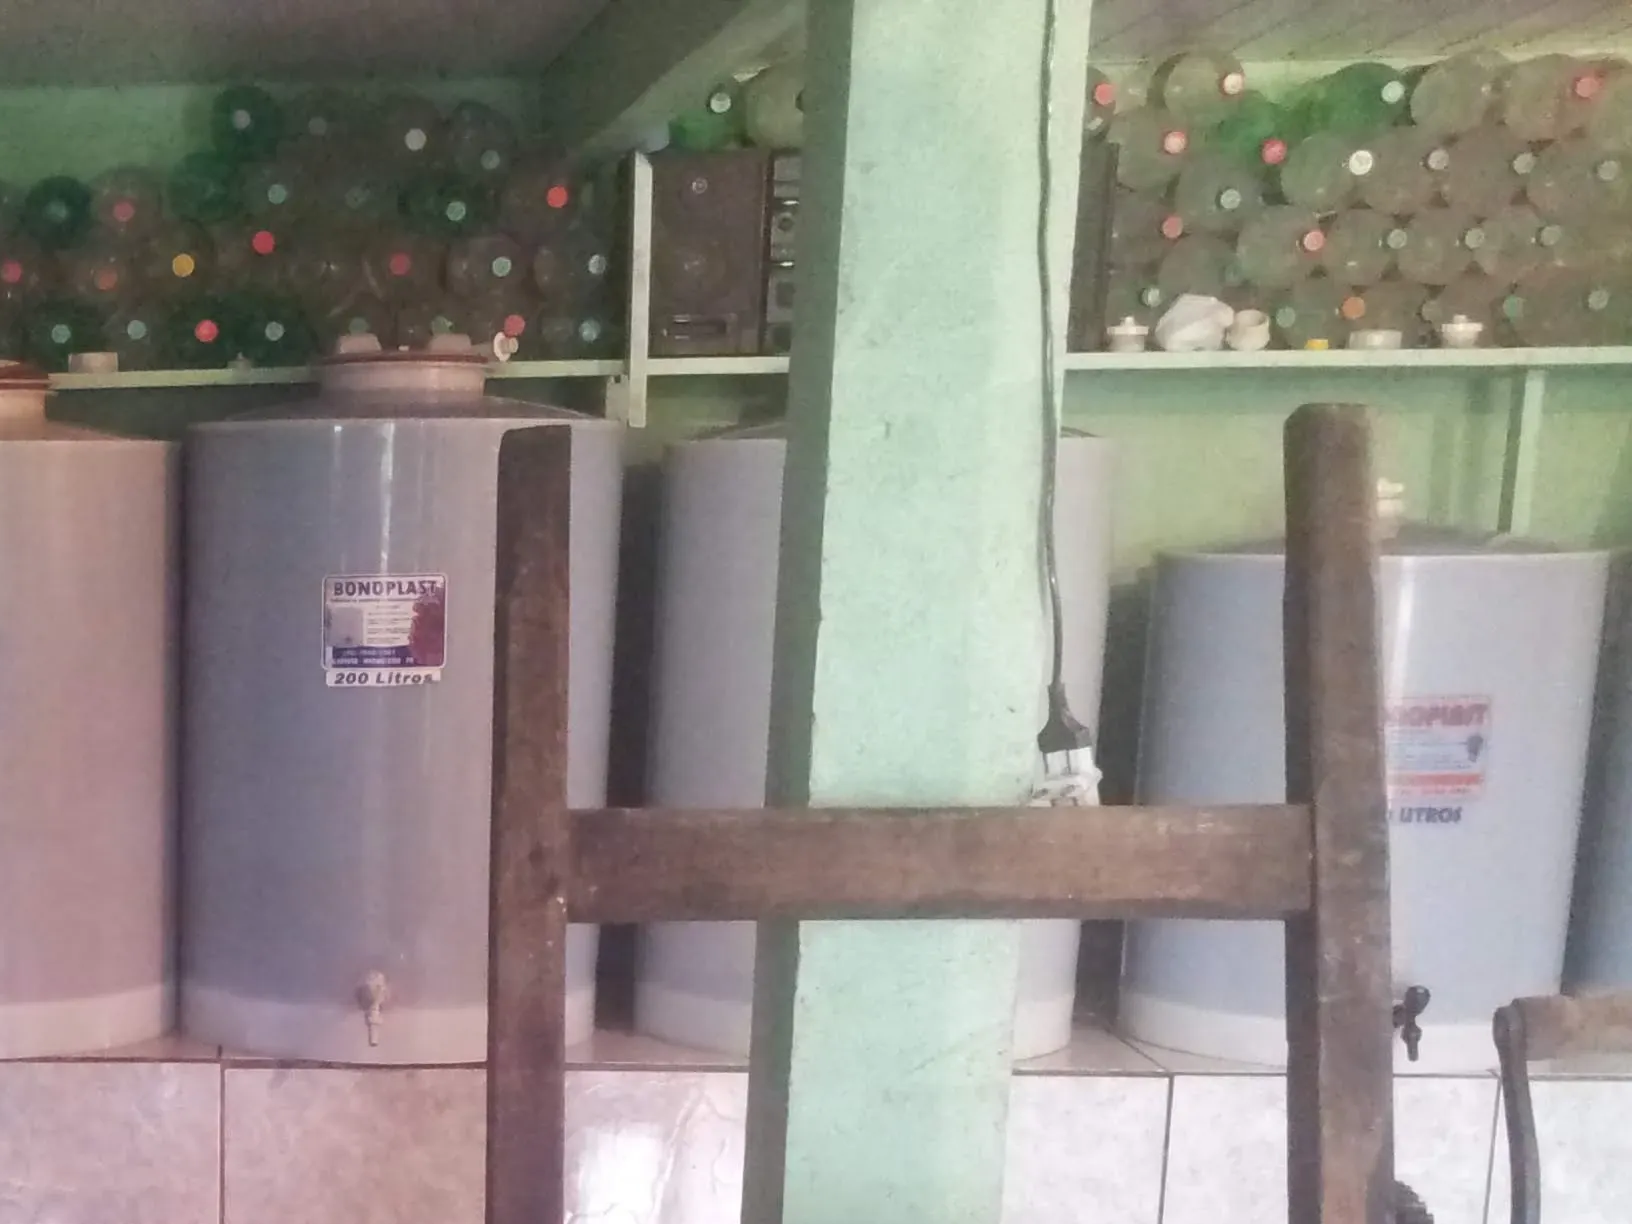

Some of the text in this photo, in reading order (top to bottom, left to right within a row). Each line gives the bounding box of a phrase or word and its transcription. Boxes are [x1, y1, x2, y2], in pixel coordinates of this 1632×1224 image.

[333, 579, 438, 597] BONOPLAST
[334, 671, 433, 685] 200 Litros
